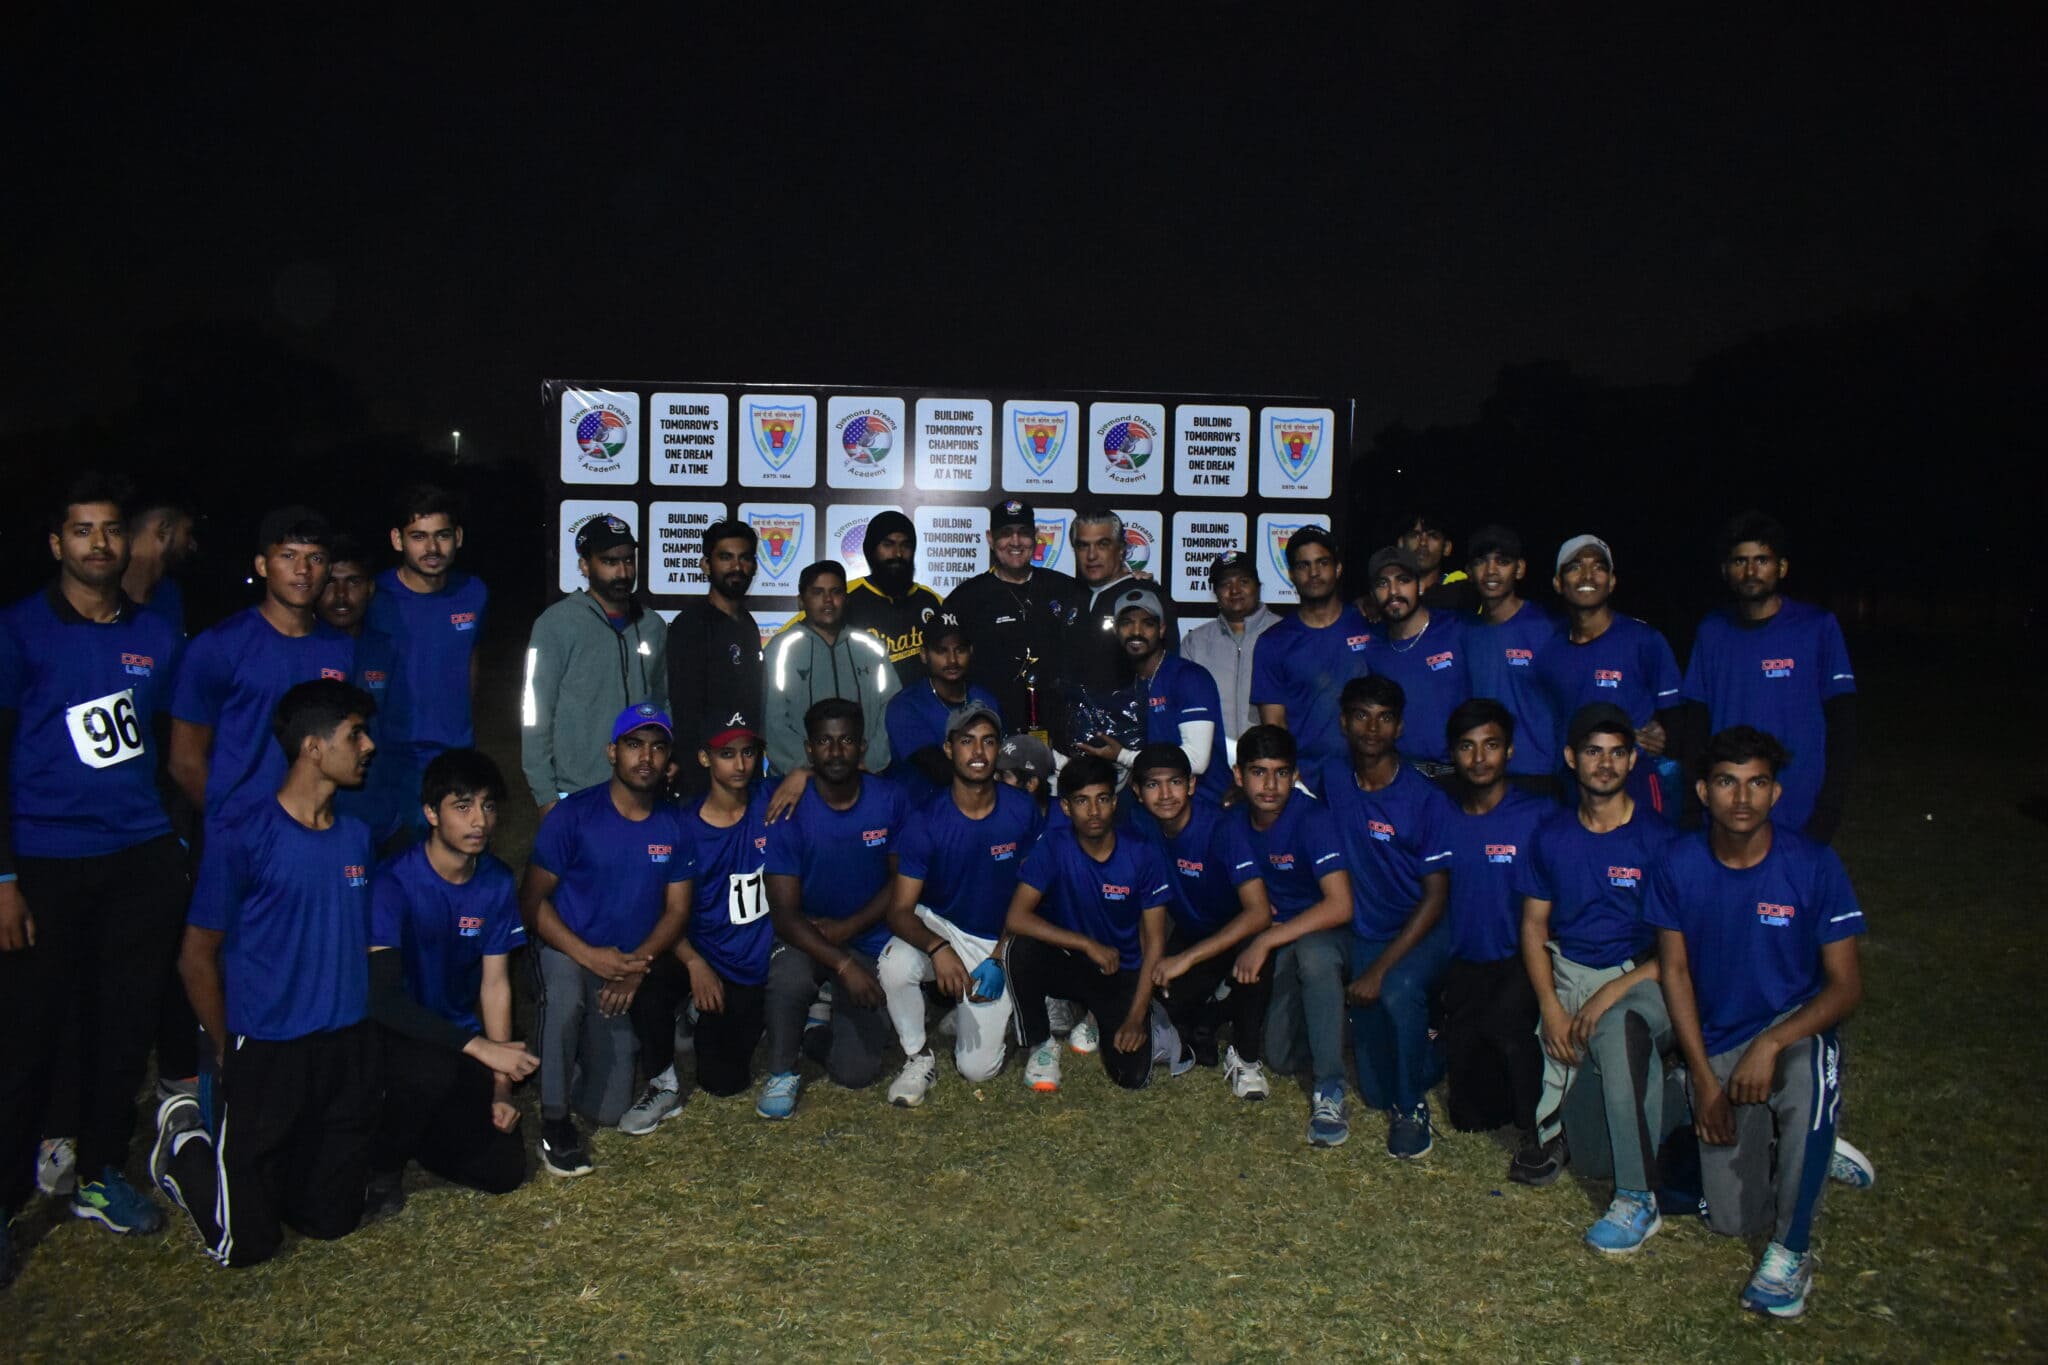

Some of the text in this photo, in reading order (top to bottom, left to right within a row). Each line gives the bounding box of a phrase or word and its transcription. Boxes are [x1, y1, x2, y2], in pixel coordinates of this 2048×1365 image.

[607, 403, 632, 426] Dreams
[669, 405, 710, 415] BUILDING
[934, 410, 974, 421] BUILDING
[660, 419, 719, 430] TOMORROW'S
[835, 408, 898, 431] Diamond Dreams
[1193, 417, 1232, 427] BUILDING
[925, 425, 983, 436] TOMORROW'S
[1097, 414, 1158, 438] Diamond Dreams
[663, 434, 715, 445] CHAMPIONS
[1184, 431, 1241, 442] TOMORROW'S
[928, 440, 979, 450] CHAMPIONS
[665, 449, 713, 460] ONE DREAM
[1187, 446, 1236, 456] CHAMPIONS
[930, 455, 977, 465] ONE DREAM
[1189, 460, 1234, 471] ONE DREAM
[582, 462, 621, 473] Academy
[669, 464, 708, 474] AT A TIME
[848, 467, 887, 478] Academy
[934, 469, 973, 480] AT A TIME
[1108, 472, 1147, 483] Academy
[1193, 474, 1230, 485] AT A TIME
[668, 513, 708, 524] BUILDING
[932, 518, 972, 529] BUILDING
[1131, 521, 1155, 543] Dreams
[1191, 523, 1229, 533] BUILDING
[923, 533, 981, 543] TOMORROW'S
[1182, 537, 1238, 548] TOMORROW'S
[927, 547, 977, 558] CHAMPIONS
[664, 557, 681, 568] ONE
[928, 561, 975, 573] ONE DREAM
[1186, 566, 1202, 576] ONE
[668, 572, 678, 583] AT
[679, 572, 686, 583] A
[932, 576, 942, 587] AT
[943, 576, 950, 587] A
[1190, 580, 1199, 591] AT
[1200, 580, 1206, 591] A
[83, 698, 141, 759] 96
[734, 874, 761, 919] 17
